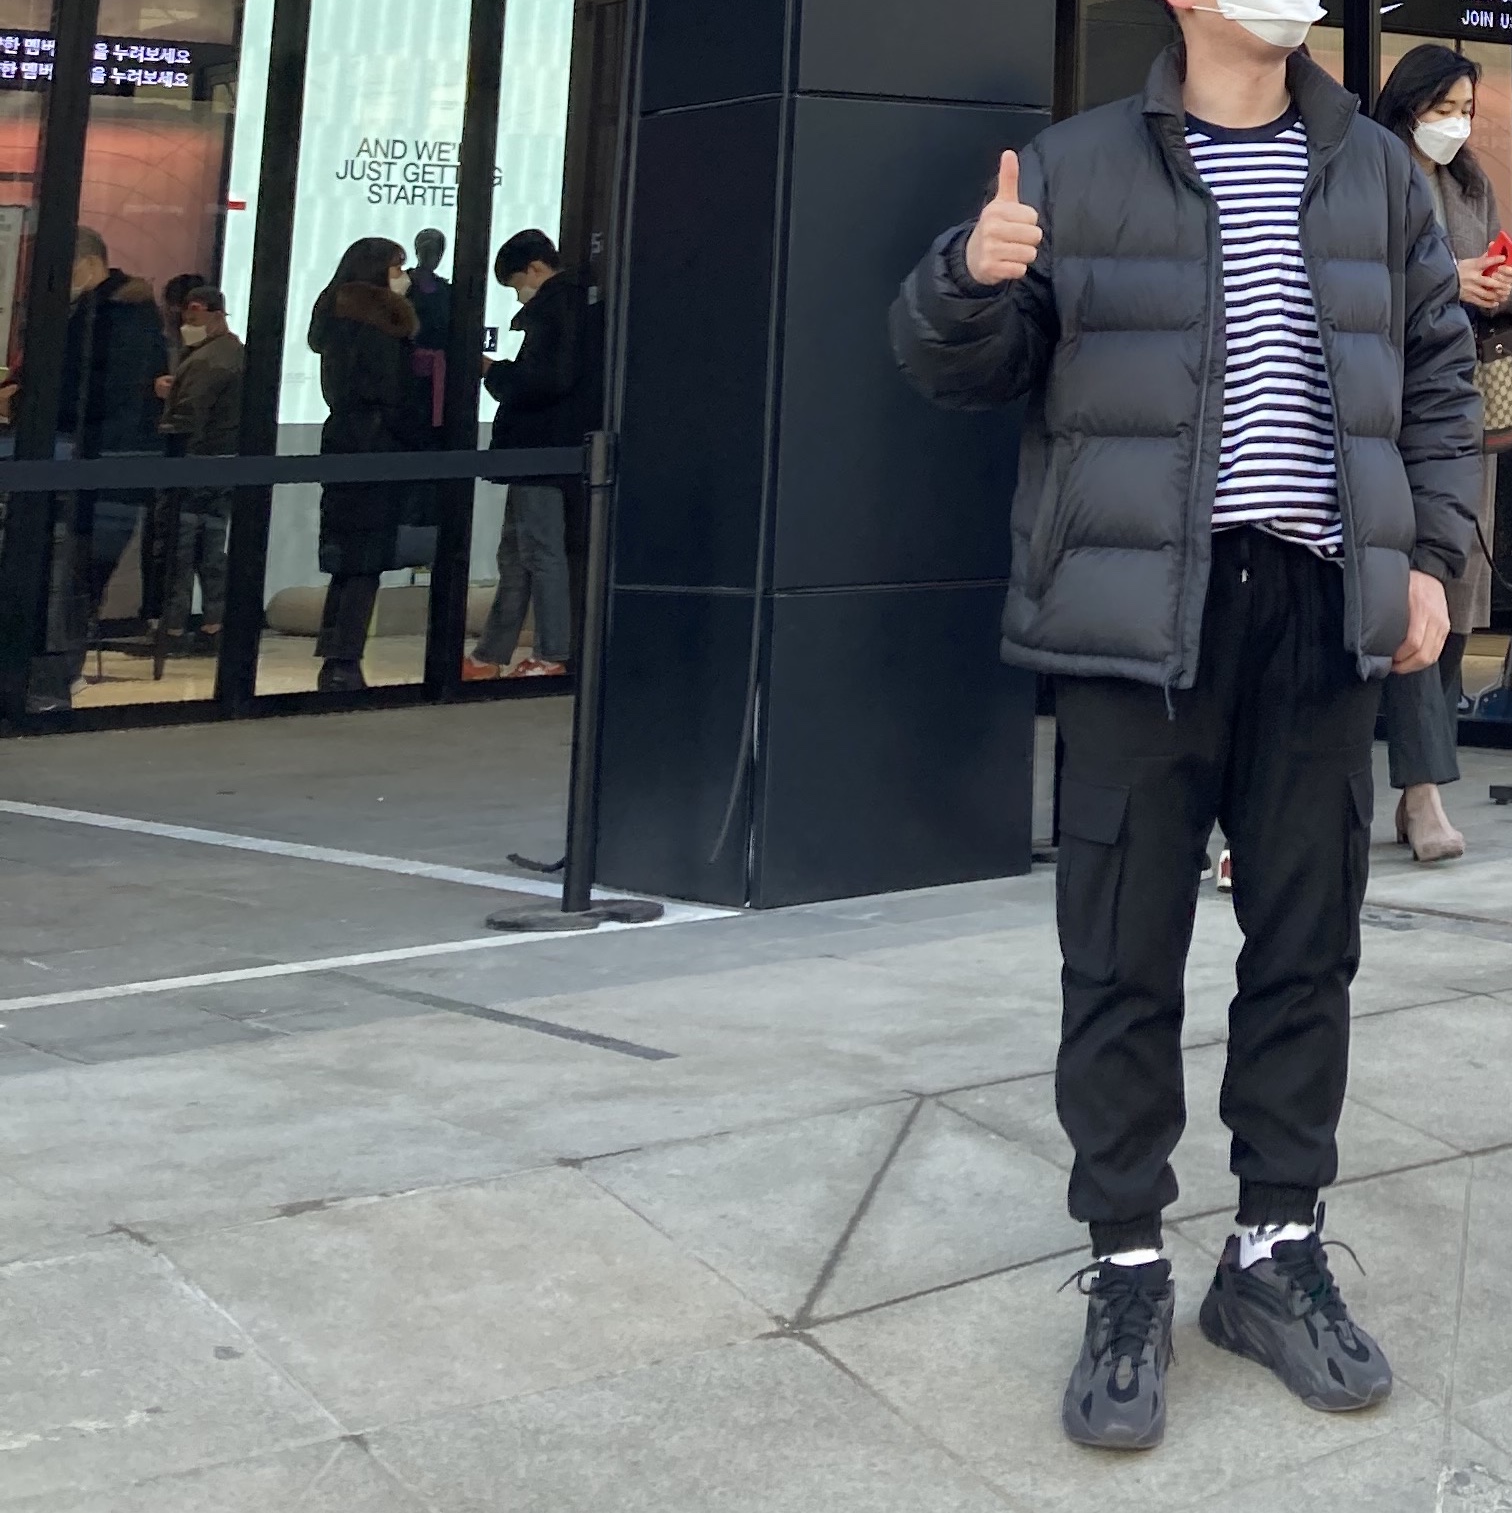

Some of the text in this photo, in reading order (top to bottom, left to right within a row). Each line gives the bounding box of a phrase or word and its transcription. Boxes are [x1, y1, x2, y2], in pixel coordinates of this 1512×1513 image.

[1461, 9, 1494, 27] JOIN
[112, 44, 191, 64] 누려보세요
[109, 67, 189, 87] 누려보세요
[356, 138, 407, 159] AND
[336, 159, 397, 181] JUST
[367, 183, 456, 207] STARTE
